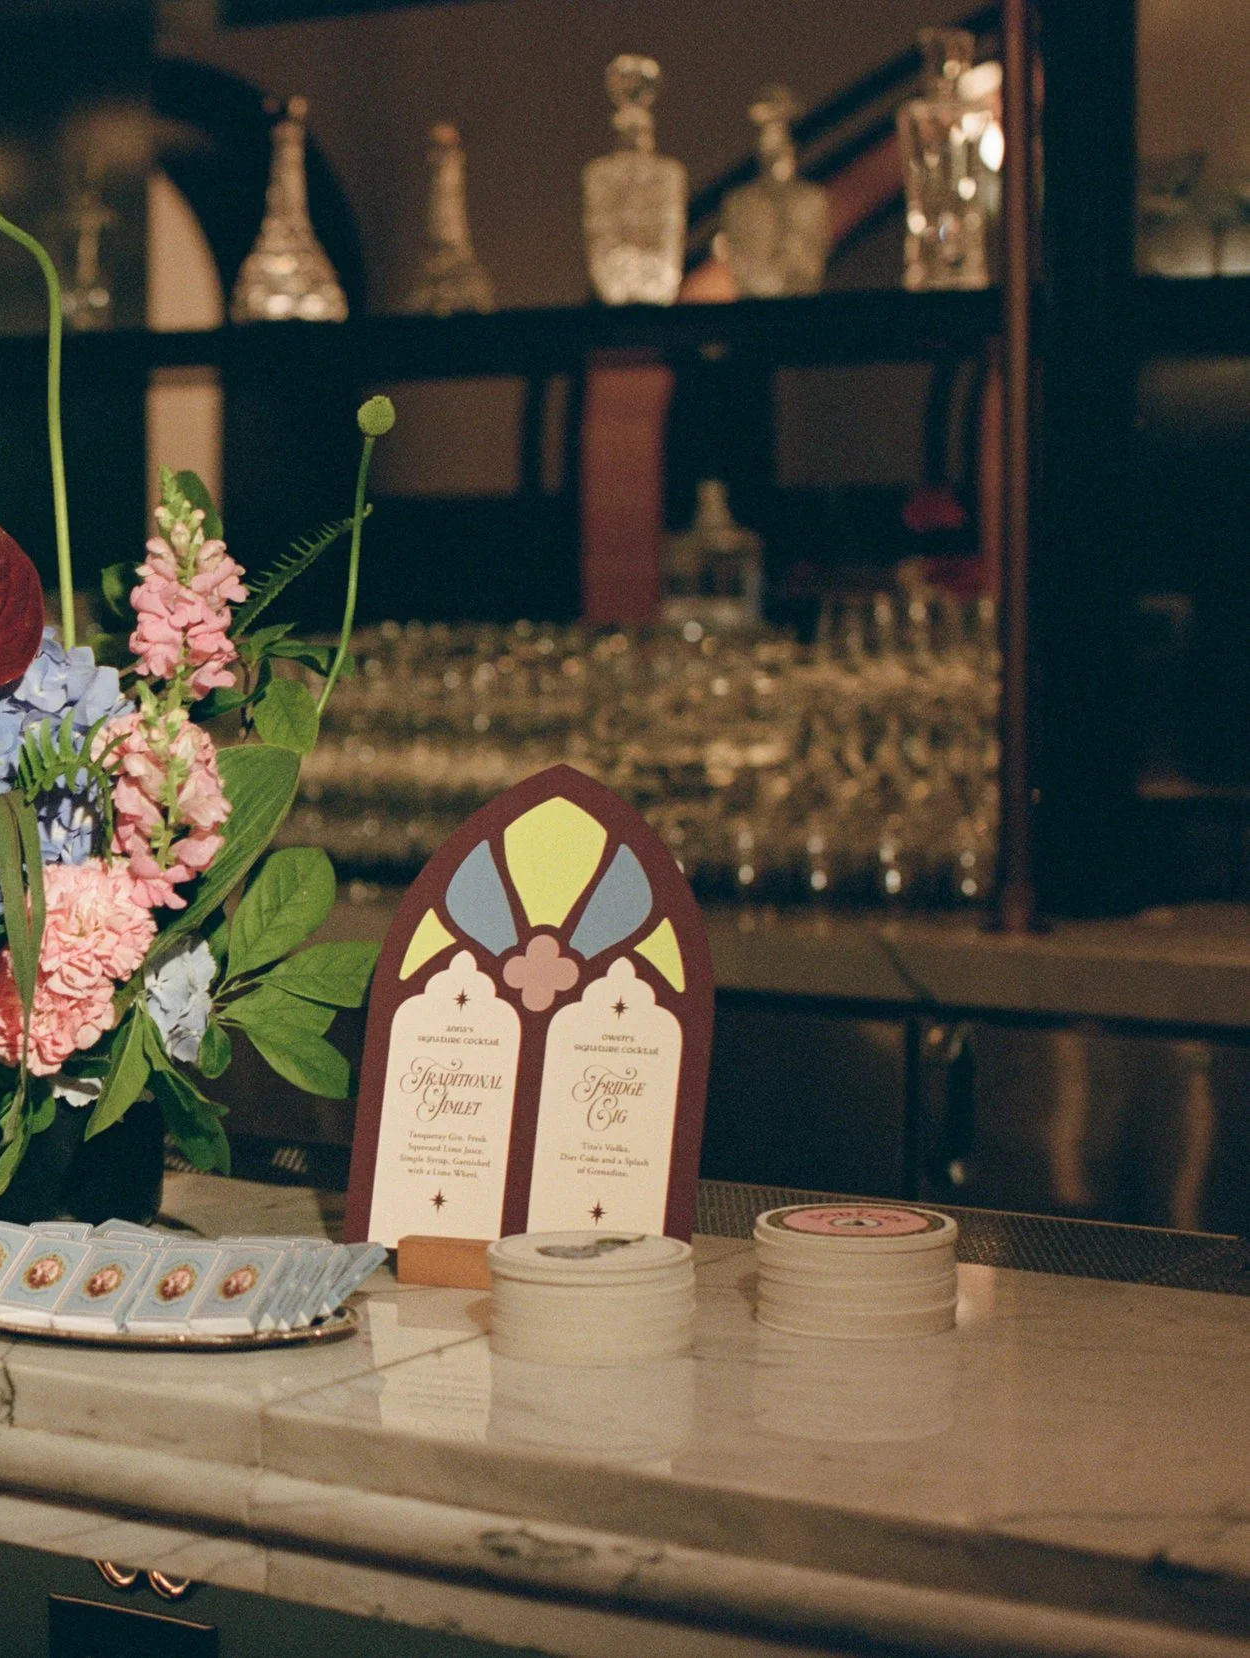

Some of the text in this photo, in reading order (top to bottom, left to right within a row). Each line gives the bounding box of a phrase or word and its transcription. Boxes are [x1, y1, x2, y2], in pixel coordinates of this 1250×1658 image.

[467, 1134, 488, 1143] Fresh
[443, 1145, 462, 1154] Lime
[399, 1153, 424, 1164] Simple
[452, 1158, 491, 1168] Garnished
[579, 1154, 600, 1163] Coke
[624, 1158, 650, 1167] Splash
[432, 1168, 452, 1177] Lime
[577, 1166, 586, 1174] of
